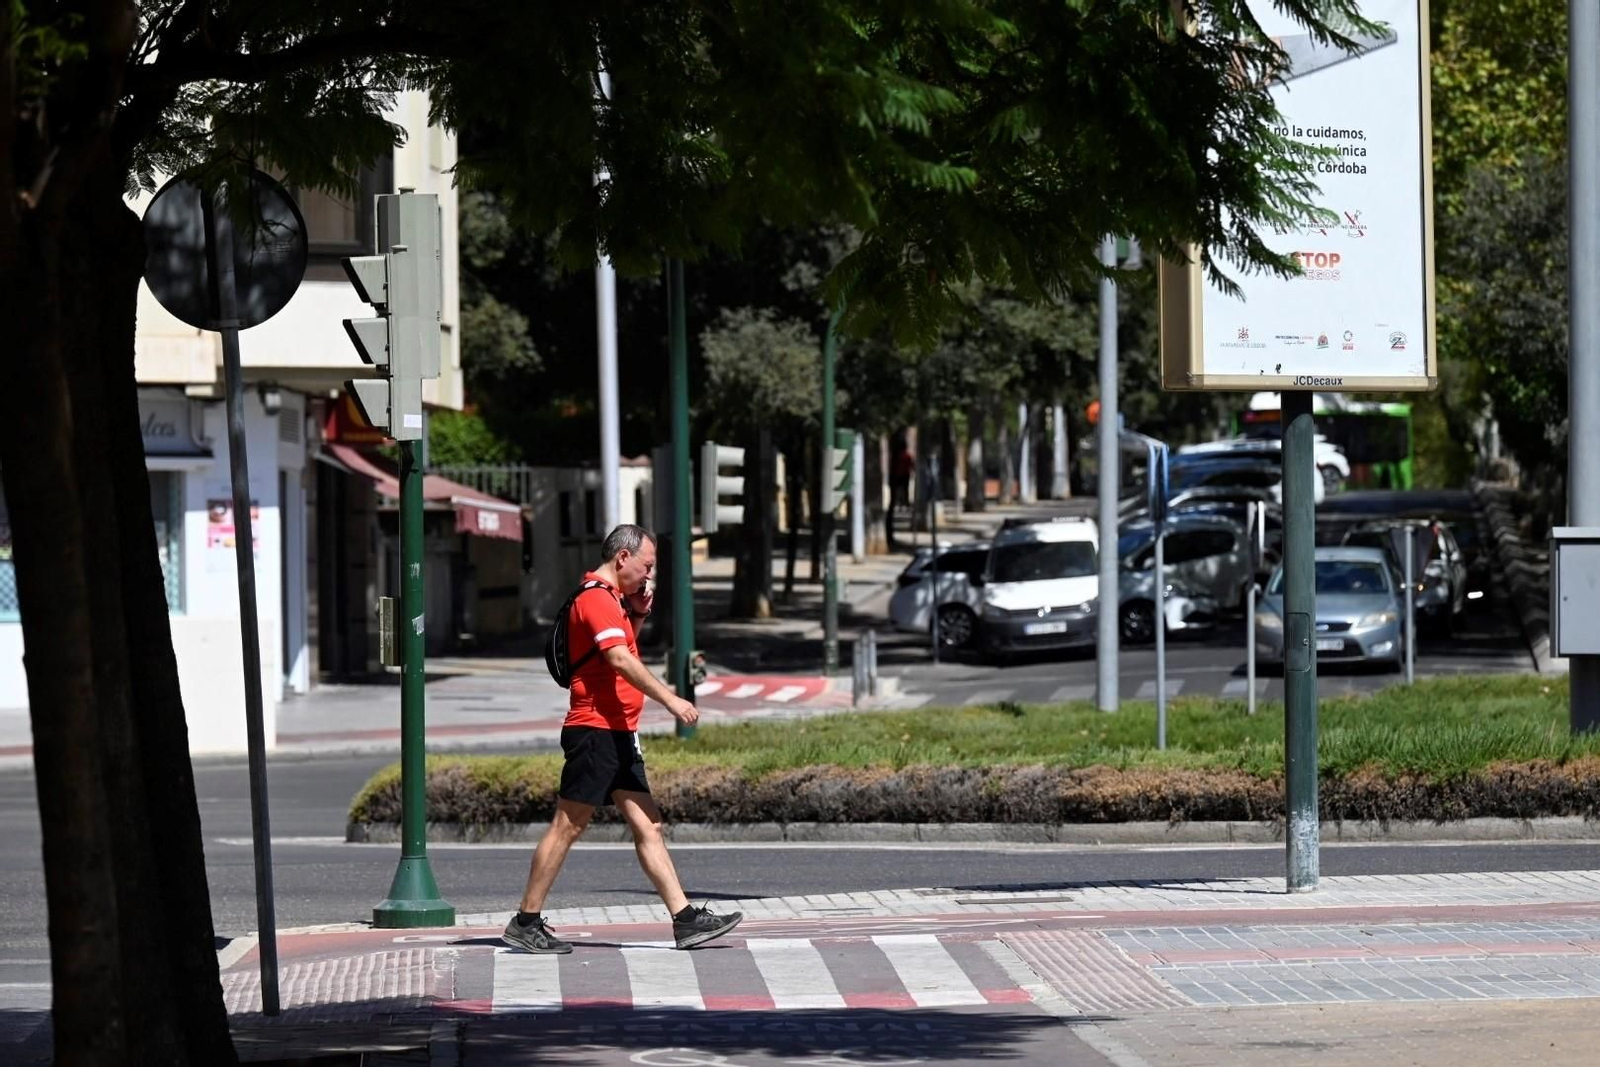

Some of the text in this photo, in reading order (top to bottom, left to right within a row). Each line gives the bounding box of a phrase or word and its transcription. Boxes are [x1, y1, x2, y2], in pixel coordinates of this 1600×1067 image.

[1274, 126, 1289, 137] no
[1292, 124, 1303, 137] la
[1306, 126, 1367, 141] cuidamos,
[1317, 161, 1367, 175] Córdoba
[1293, 375, 1343, 387] JCDecaux
